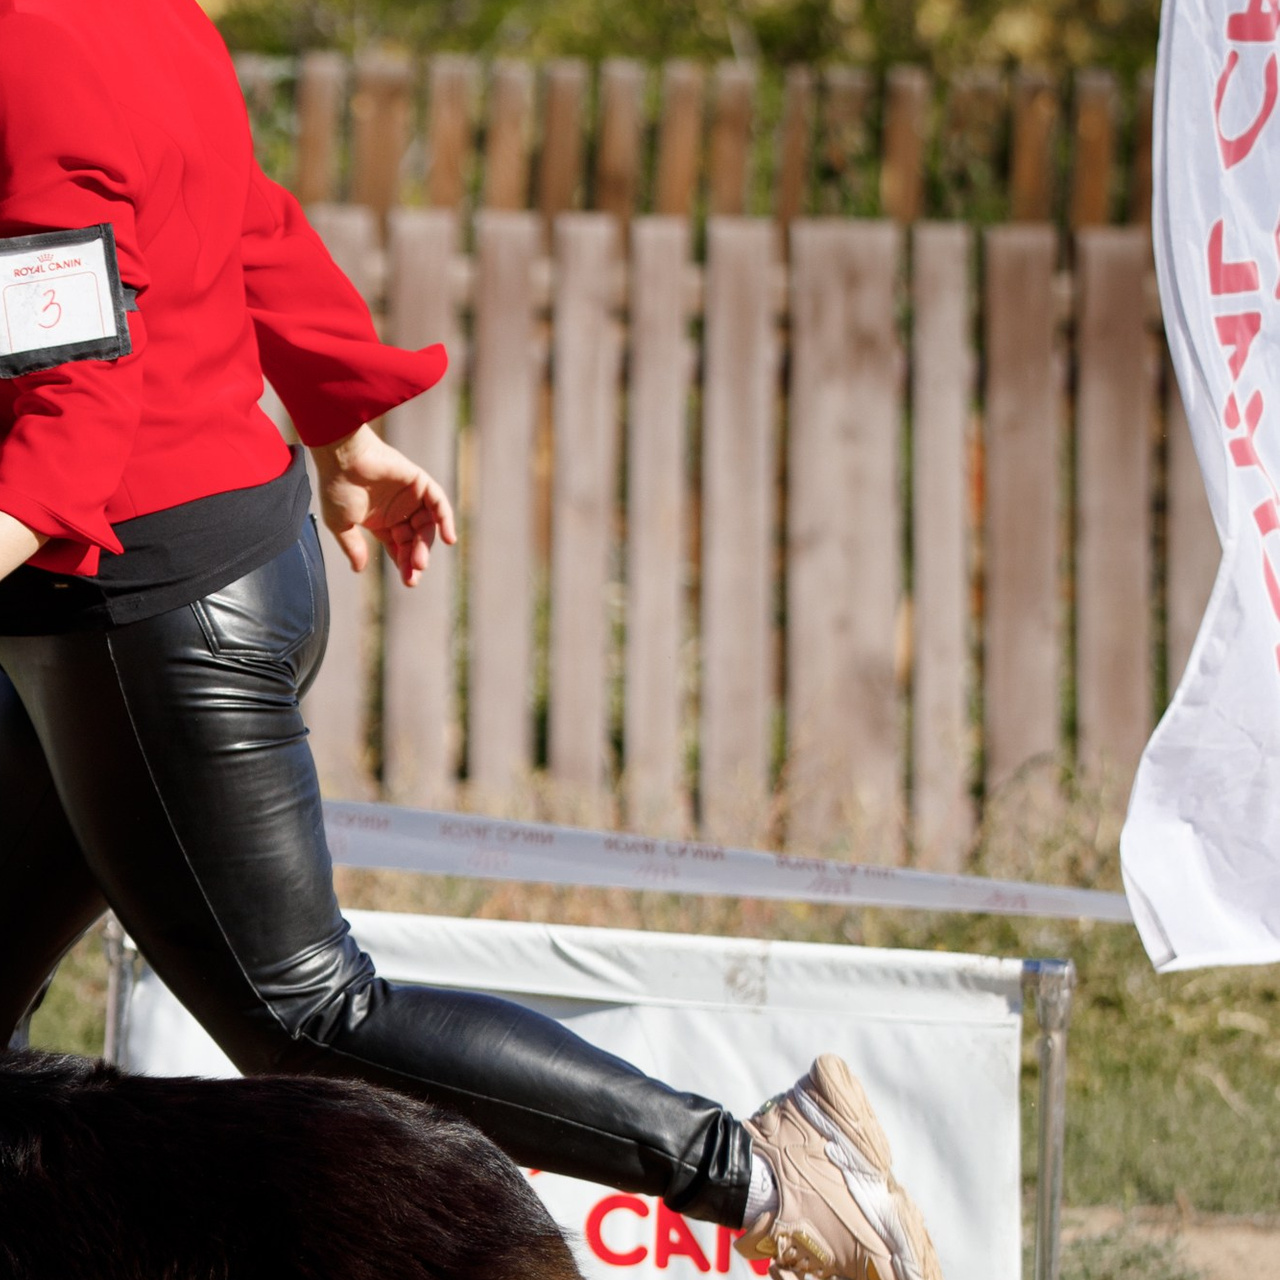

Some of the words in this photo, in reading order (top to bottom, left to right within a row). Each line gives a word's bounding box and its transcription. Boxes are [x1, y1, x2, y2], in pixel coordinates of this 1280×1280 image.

[13, 265, 46, 278] ROYAL
[48, 258, 82, 271] CANIN
[38, 289, 62, 329] 3
[585, 1193, 770, 1276] CAN
